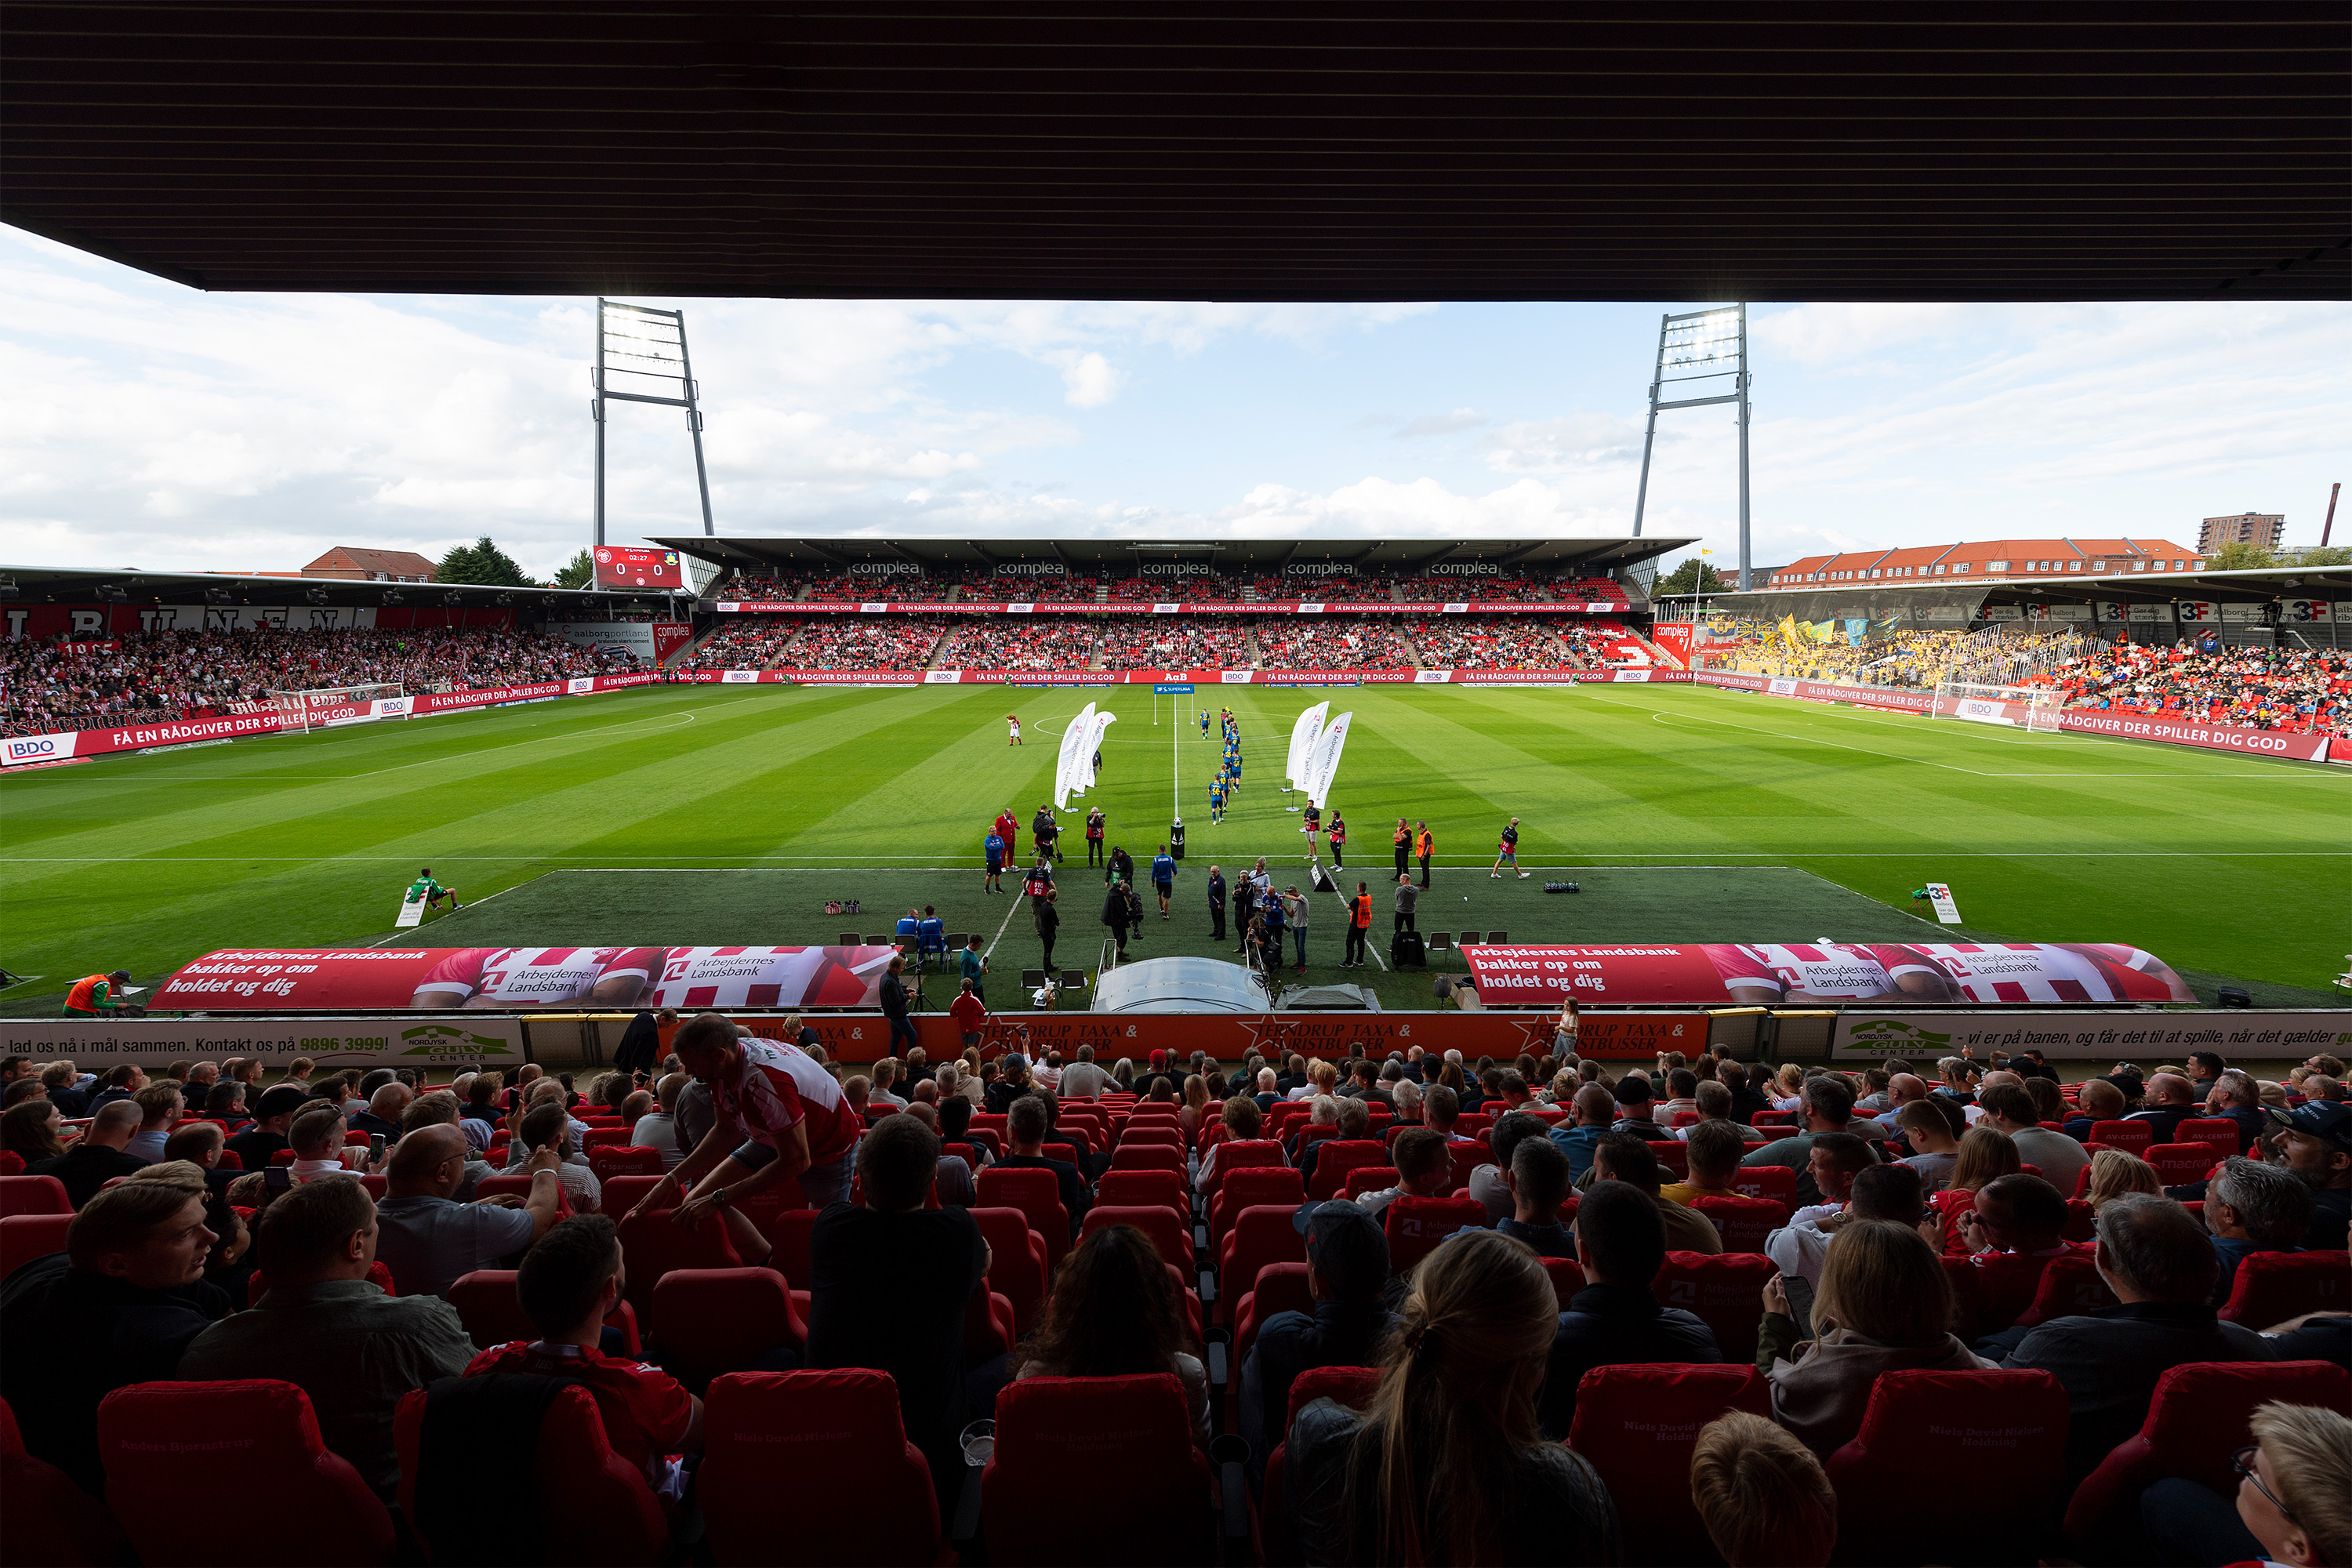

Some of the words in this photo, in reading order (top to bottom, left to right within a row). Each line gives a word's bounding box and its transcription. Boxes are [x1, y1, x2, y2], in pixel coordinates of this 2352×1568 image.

[616, 563, 626, 575] 0
[653, 564, 662, 575] 0
[851, 561, 919, 577] complea
[998, 561, 1065, 577] complea
[1143, 561, 1209, 577] complea
[1288, 561, 1352, 577] complea
[1432, 561, 1497, 577] complea
[2028, 604, 2049, 619] 3F
[2181, 602, 2209, 620] 3F
[2292, 601, 2327, 620] 3F
[575, 629, 648, 639] aalborgportland
[658, 626, 689, 640] complea
[1657, 624, 1689, 639] complea
[1164, 673, 1187, 681] AaB
[1777, 682, 1790, 691] BDO
[431, 695, 441, 707] FÅ
[442, 696, 453, 706] EN
[455, 691, 492, 704] RÅDGIVER
[494, 690, 507, 699] DER
[534, 686, 545, 695] DIG
[546, 684, 560, 694] GOD
[1808, 685, 1816, 695] FÅ
[1827, 687, 1860, 700] RÅDGIVER
[1862, 692, 1876, 702] DER
[1877, 693, 1905, 705] SPILLER
[1907, 696, 1922, 706] DIG
[1924, 699, 1944, 710] GOD
[383, 702, 403, 711] BDO
[1971, 703, 1991, 714] BDO
[113, 730, 133, 746] FÅ
[136, 729, 157, 743] EN
[161, 718, 233, 741] RÅDGIVER
[236, 716, 260, 731] DER
[263, 712, 306, 728] SPILLER
[310, 710, 329, 722] DIG
[332, 708, 356, 719] GOD
[2040, 712, 2057, 724] EN
[2058, 712, 2121, 732] RÅDGIVER
[2124, 720, 2151, 737] DER
[2154, 724, 2209, 742] SPILLER
[2212, 731, 2242, 747] DIG
[2246, 735, 2288, 752] GOD
[14, 740, 54, 756] BDO
[1929, 887, 1950, 900] 3F
[202, 952, 321, 961] Arbejdernes
[323, 951, 428, 960] Landsbank
[1471, 948, 1577, 957] Arbejdernes
[1581, 947, 1681, 956] Landsbank
[1964, 953, 2040, 964] Arbejdernes
[696, 956, 776, 968] Arbejdernes
[1476, 958, 1540, 971] bakker
[1544, 960, 1569, 973] op
[1573, 960, 1602, 970] om
[1973, 961, 2043, 975] Landsbank
[182, 962, 255, 975] bakker
[256, 964, 281, 978] op
[285, 964, 318, 974] om
[514, 970, 593, 982] Arbejdernes
[691, 967, 760, 978] Landsbank
[1805, 964, 1882, 977] Arbejdernes
[165, 978, 233, 993] holdet
[234, 981, 260, 996] og
[262, 978, 298, 996] dig
[507, 982, 580, 993] Landsbank
[1482, 974, 1543, 989] holdet
[1547, 977, 1572, 992] og
[1574, 975, 1606, 992] dig
[1811, 977, 1882, 989] Landsbank
[819, 1027, 846, 1039] AXA
[851, 1026, 862, 1040] &
[1079, 1025, 1120, 1037] TAXA
[1126, 1025, 1137, 1037] &
[1257, 1025, 1345, 1036] TERNDRUP
[1352, 1025, 1394, 1036] TAXA
[1399, 1024, 1410, 1036] &
[1530, 1024, 1618, 1036] TERDRUP
[1626, 1024, 1667, 1036] TAXA
[1671, 1024, 1683, 1036] &
[1271, 1038, 1384, 1050] TURISTBUSSER
[1968, 1030, 1981, 1044] vi
[1984, 1033, 2001, 1044] er
[2004, 1029, 2021, 1047] på
[2024, 1029, 2070, 1046] banen,
[2075, 1033, 2093, 1047] og
[2097, 1028, 2118, 1044] får
[2122, 1029, 2145, 1044] det
[2147, 1029, 2163, 1044] til
[2165, 1031, 2182, 1044] at
[2184, 1029, 2223, 1047] spille,
[2227, 1028, 2254, 1044] når
[2256, 1029, 2280, 1044] det
[2283, 1029, 2336, 1047] gælder
[9, 1039, 33, 1053] lad
[36, 1042, 54, 1053] os
[59, 1036, 78, 1053] nå
[82, 1039, 85, 1053] i
[89, 1036, 118, 1053] mål
[122, 1041, 190, 1052] sammen.
[196, 1038, 252, 1052] Kontakt
[256, 1041, 274, 1052] os
[278, 1036, 296, 1056] på
[299, 1037, 340, 1051] 9896
[344, 1037, 389, 1051] 3999!
[2161, 1157, 2212, 1170] macron
[1763, 1191, 1786, 1200] Aalborg
[1730, 1219, 1780, 1230] Arbejdernes
[1729, 1229, 1770, 1239] Landsban
[1704, 1282, 1763, 1294] Arbejderne
[1928, 1425, 1963, 1436] Niels
[1965, 1426, 2003, 1437] David
[2005, 1425, 2045, 1436] Nielsen
[121, 1439, 166, 1451] Anders
[1962, 1437, 2017, 1449] Holdning
